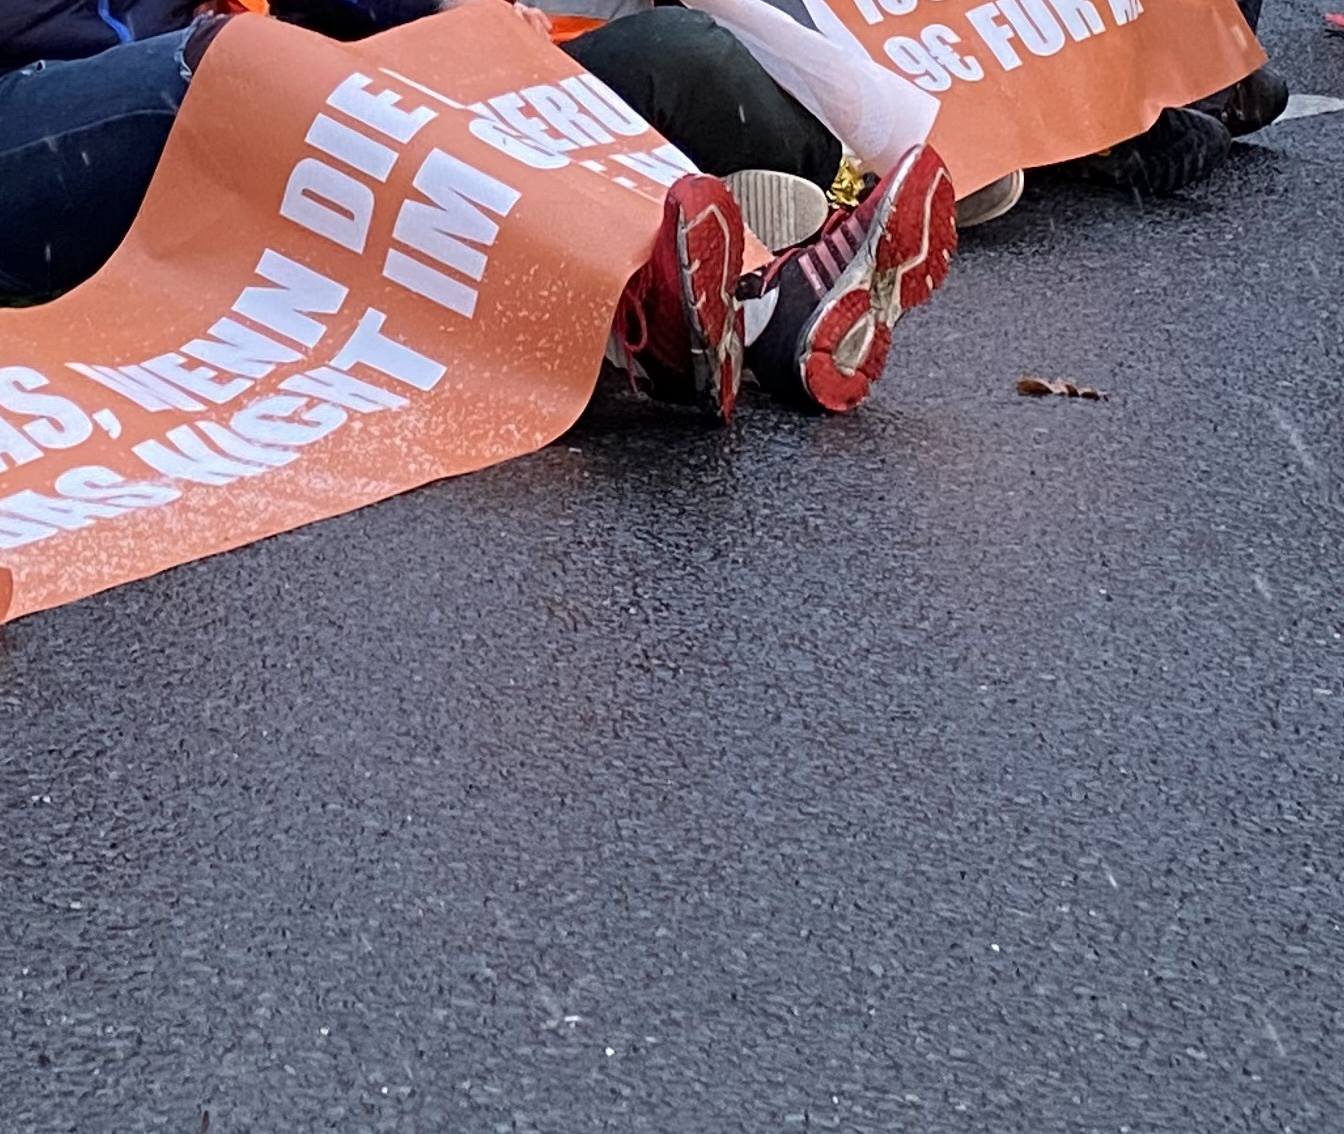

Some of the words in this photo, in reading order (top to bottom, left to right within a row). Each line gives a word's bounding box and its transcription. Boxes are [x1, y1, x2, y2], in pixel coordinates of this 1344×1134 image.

[883, 23, 985, 94] 9€
[63, 247, 350, 413] WENN
[279, 69, 440, 255] DIE
[131, 306, 448, 487] NICHT
[383, 147, 523, 320] IM
